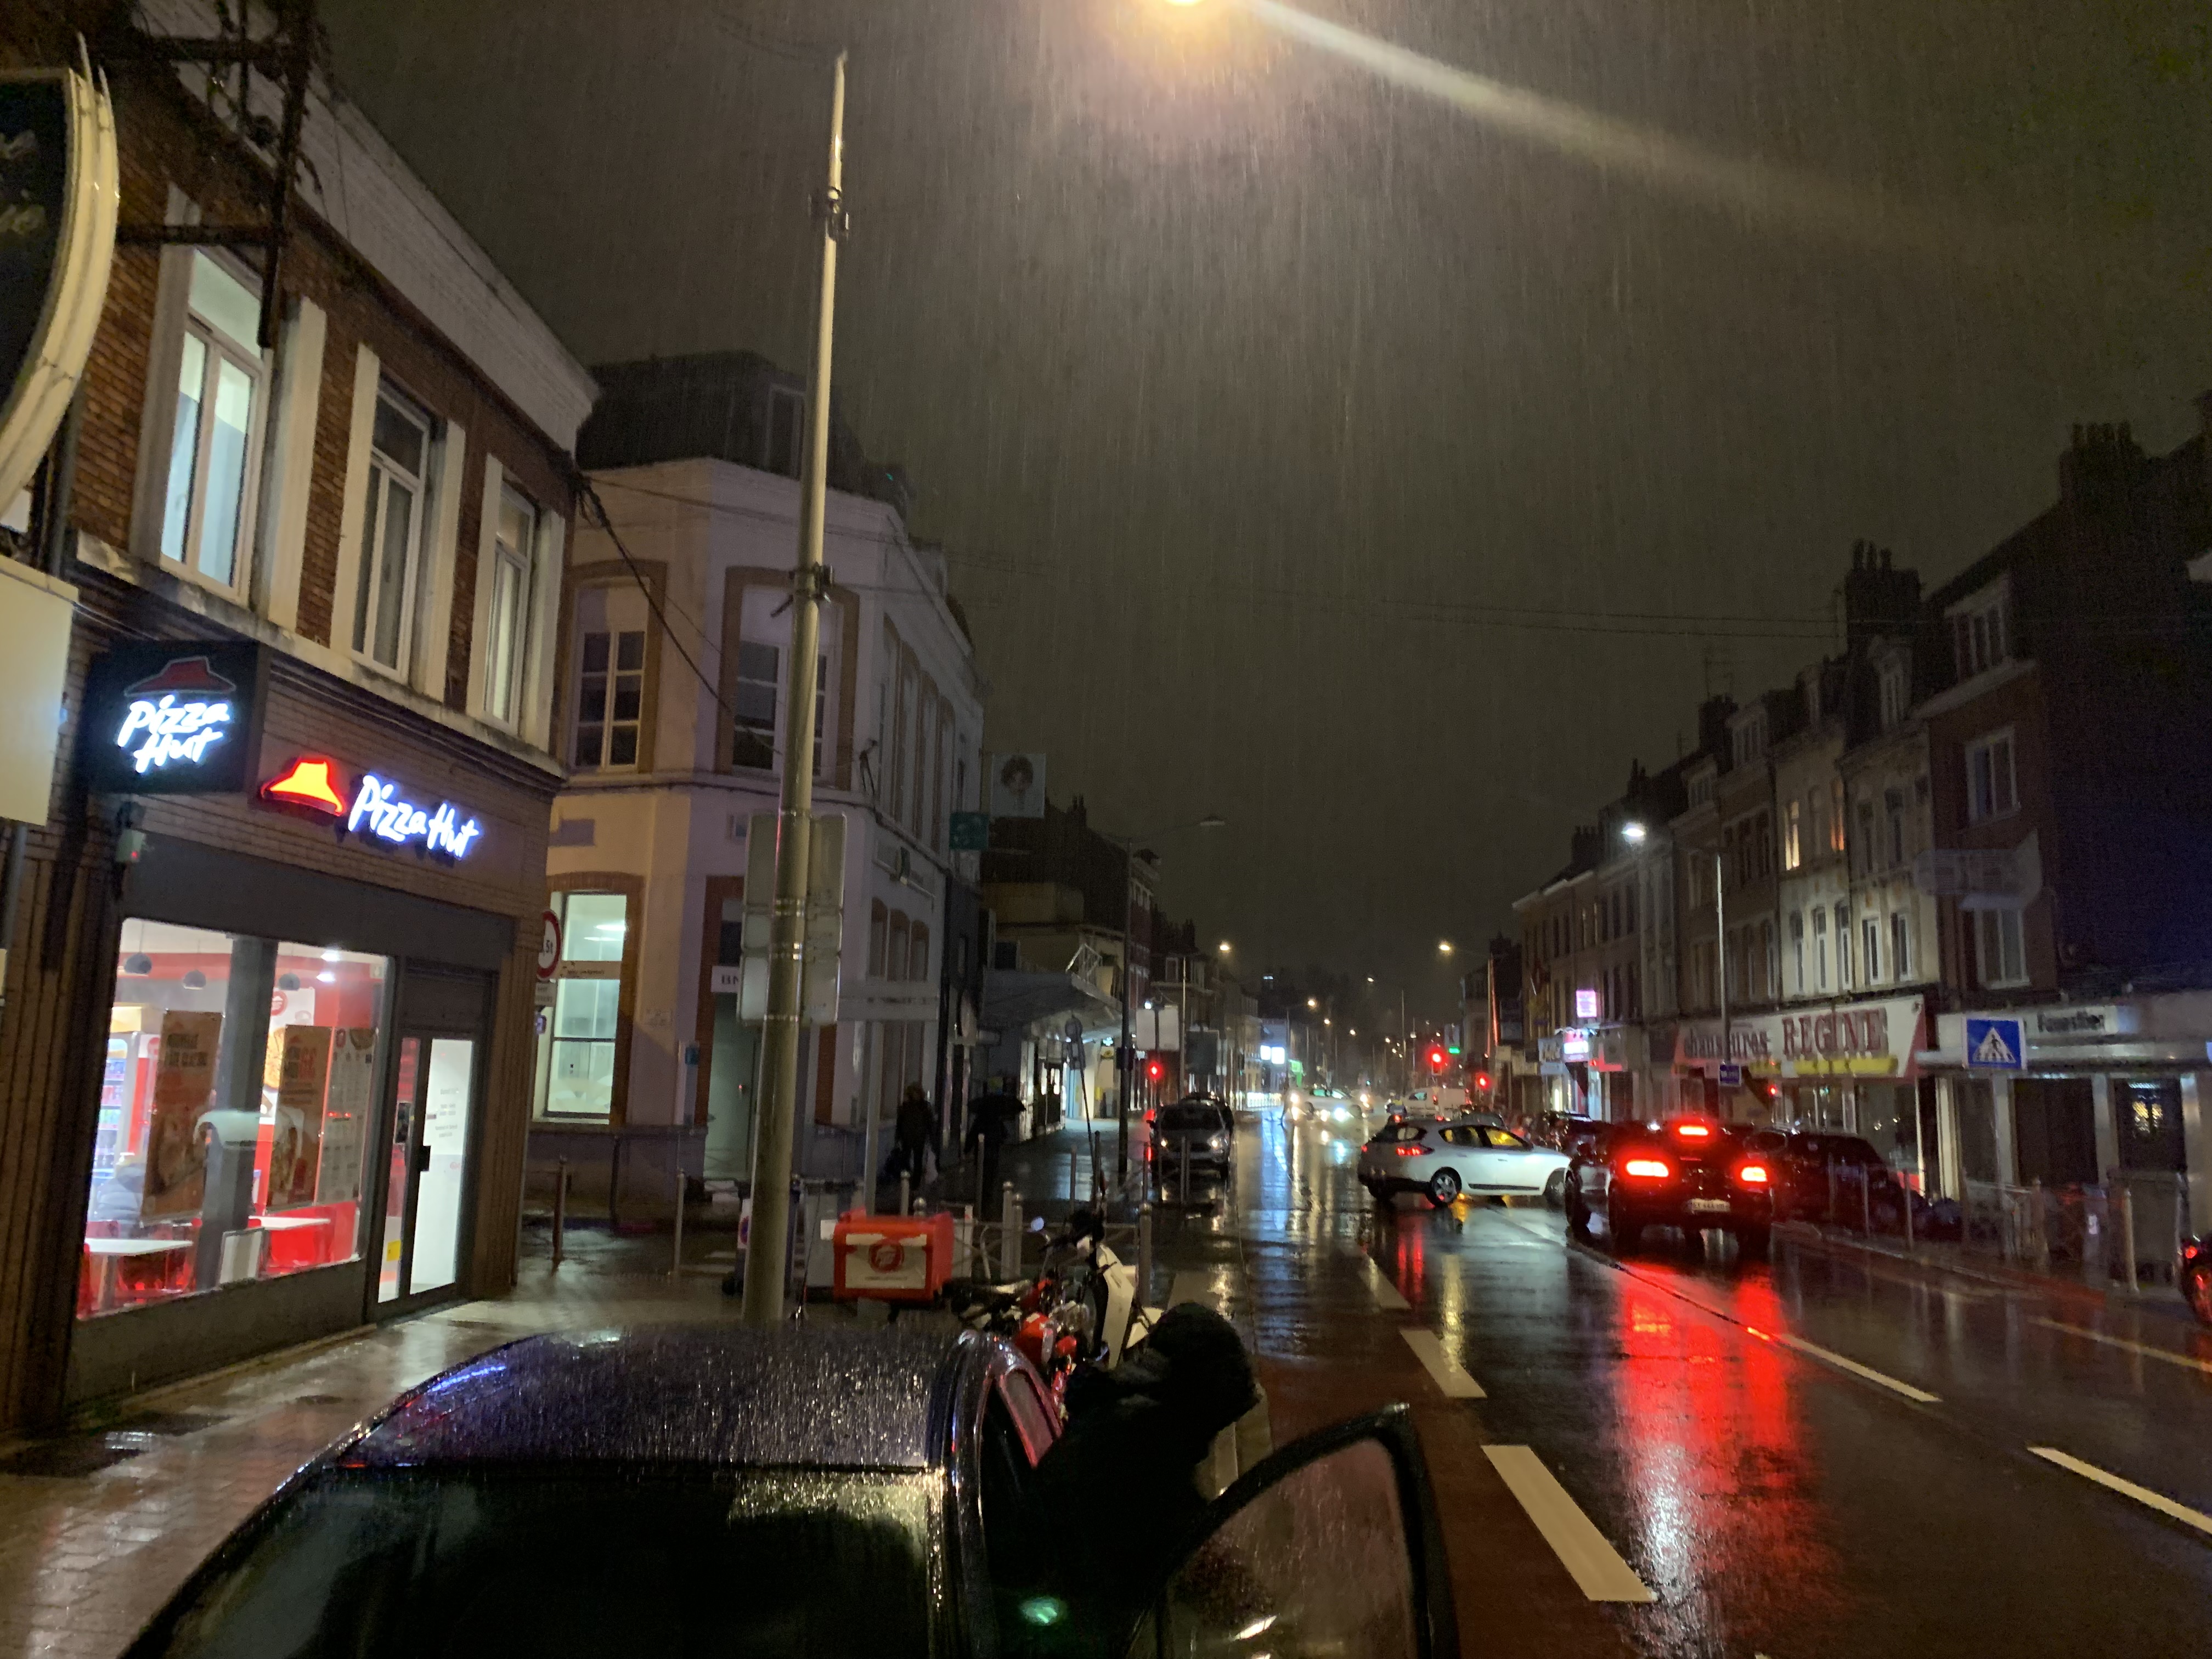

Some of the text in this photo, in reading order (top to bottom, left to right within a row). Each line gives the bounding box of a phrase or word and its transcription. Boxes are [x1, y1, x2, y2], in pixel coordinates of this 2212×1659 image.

[117, 695, 229, 747] Pizza
[133, 728, 223, 773] Hut
[348, 775, 480, 857] Pizza Hut
